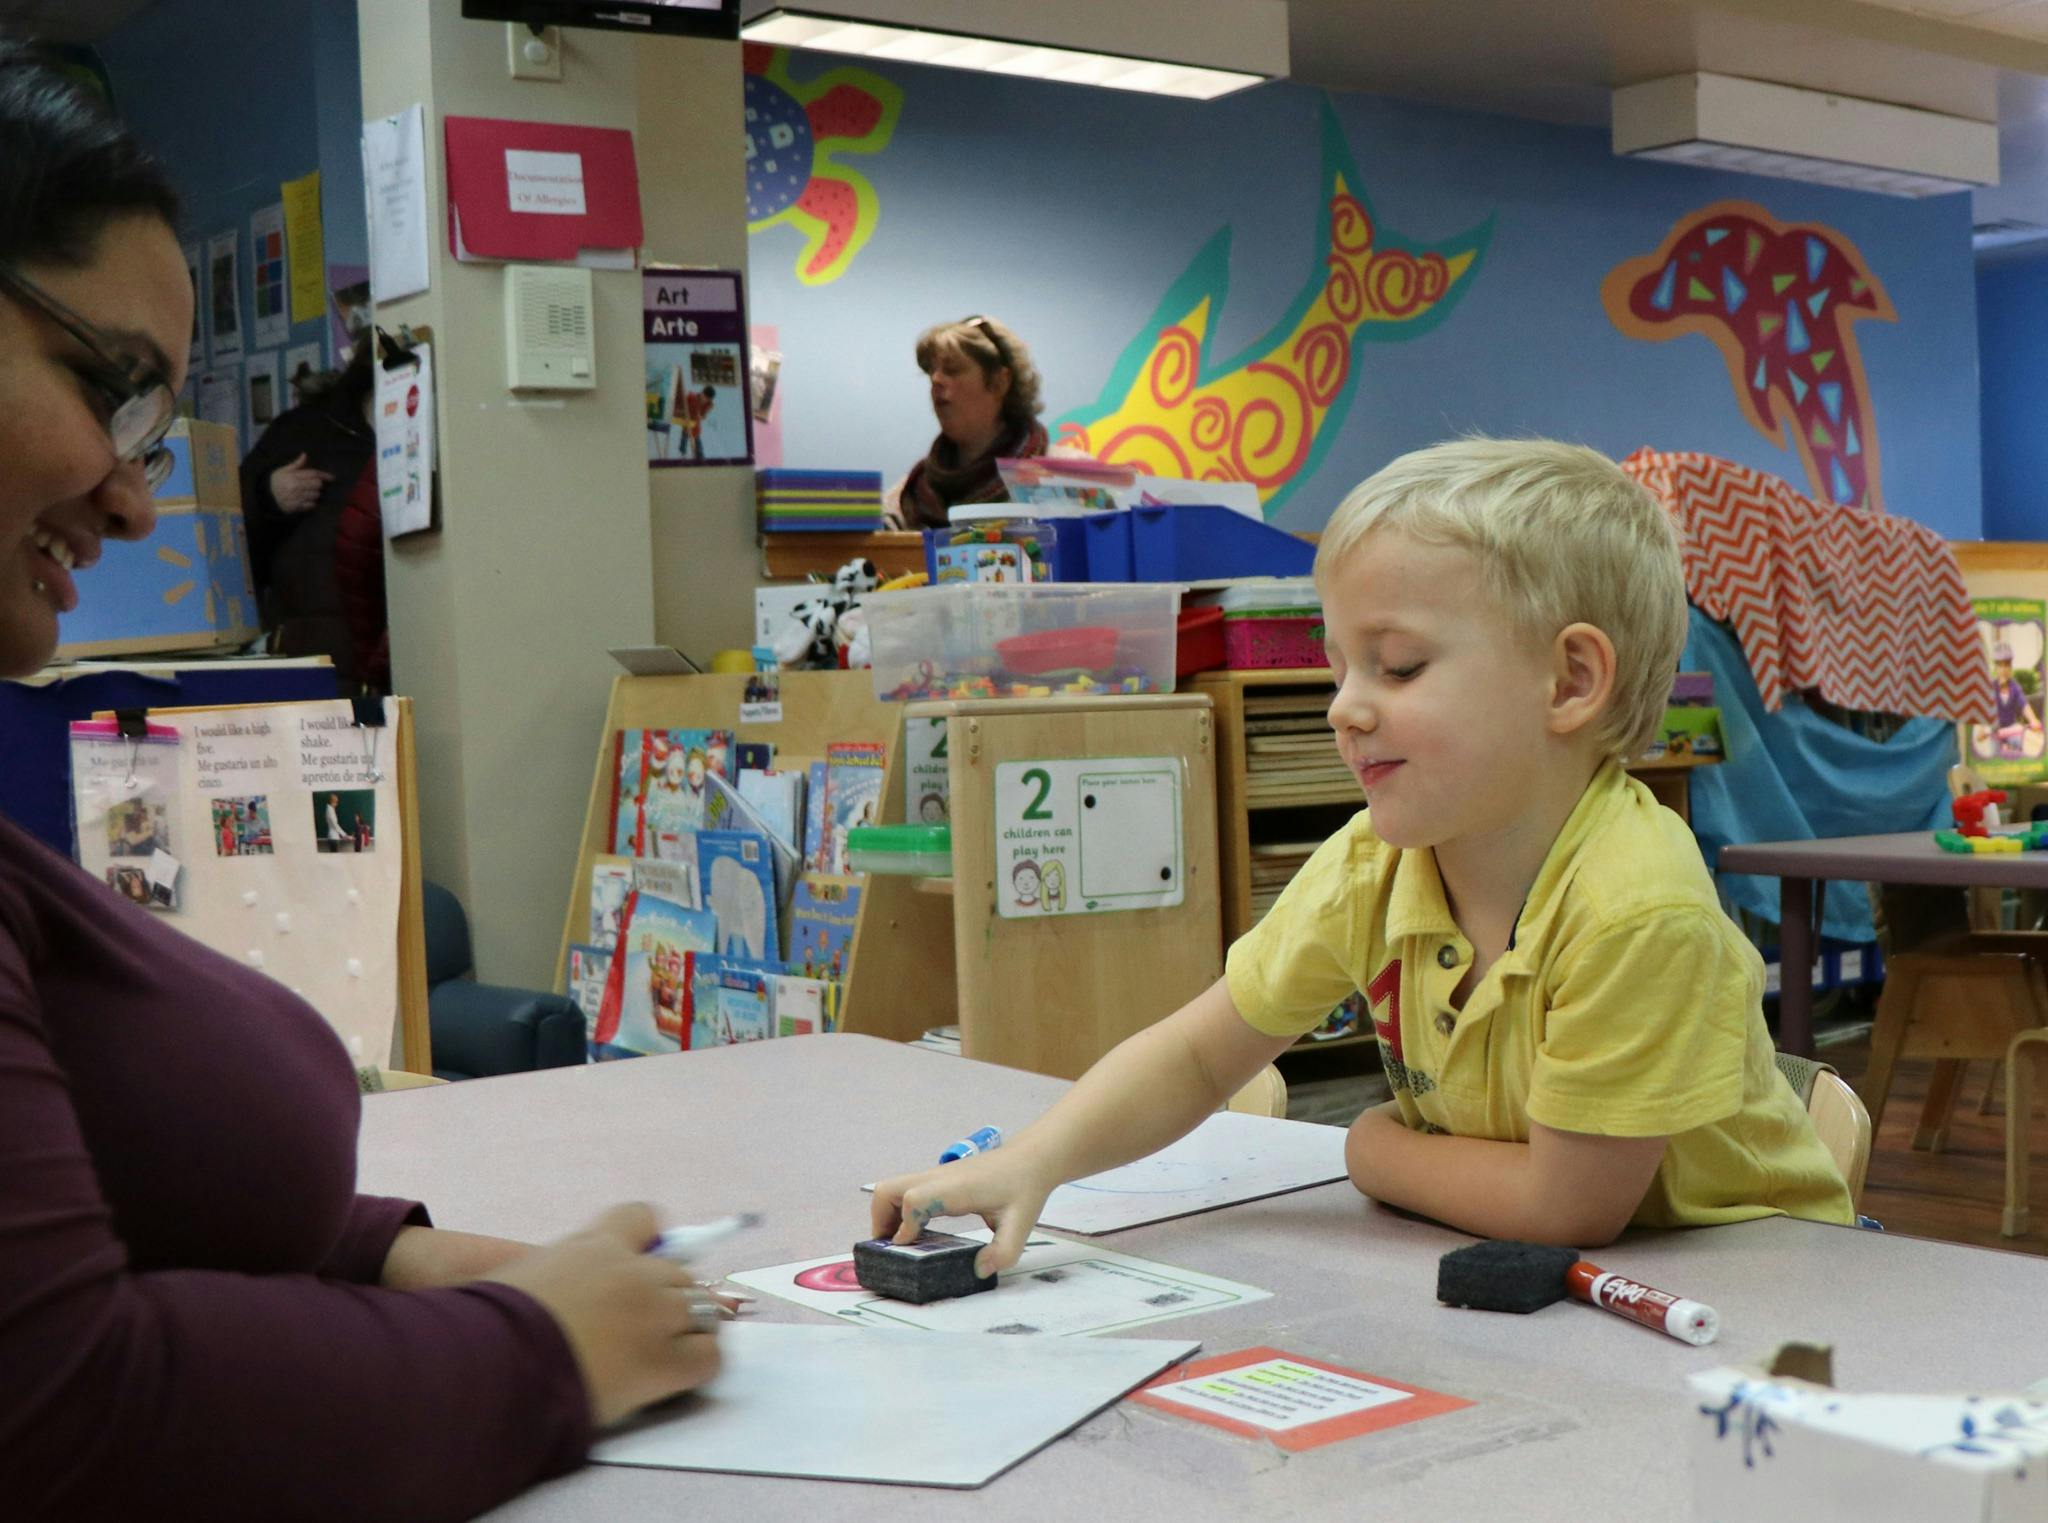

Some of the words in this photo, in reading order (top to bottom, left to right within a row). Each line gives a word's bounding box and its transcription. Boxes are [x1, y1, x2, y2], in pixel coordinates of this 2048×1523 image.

[657, 286, 689, 305] Art
[652, 317, 699, 337] Arte
[306, 717, 335, 730] would
[336, 716, 356, 729] lik
[300, 735, 332, 748] shake.
[300, 753, 317, 765] Me
[912, 763, 948, 774] childre
[921, 780, 944, 793] play
[1021, 768, 1053, 820] 2
[1003, 827, 1051, 839] children
[1055, 828, 1073, 837] can
[1013, 844, 1039, 860] play
[1042, 843, 1066, 854] here
